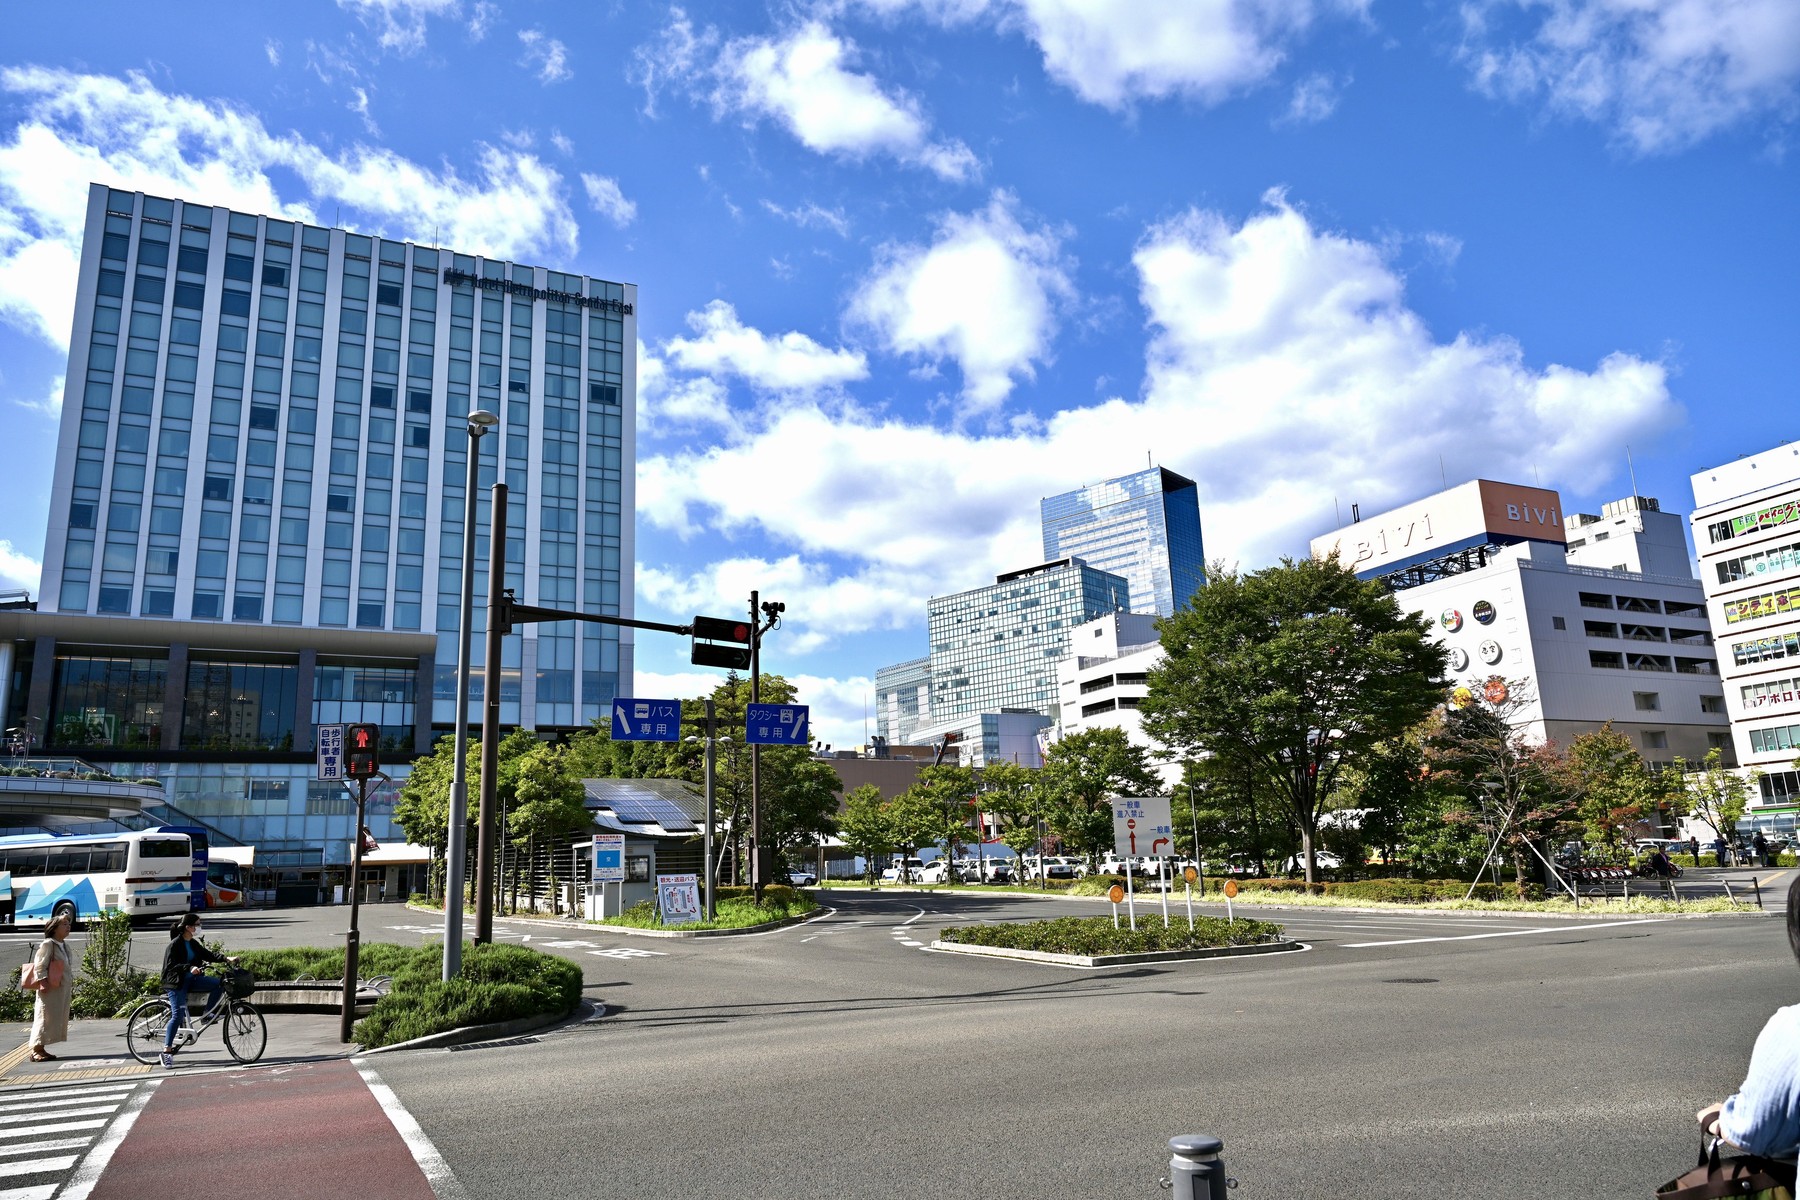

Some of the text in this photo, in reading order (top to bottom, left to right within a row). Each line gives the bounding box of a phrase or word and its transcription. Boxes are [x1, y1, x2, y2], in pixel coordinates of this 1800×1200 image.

[471, 273, 633, 315] Hotel Metropolitan Sendai East
[1505, 502, 1558, 527] BiVi
[1756, 691, 1800, 706] アポロ
[651, 706, 674, 718] バス
[750, 709, 779, 721] タクシー
[640, 723, 667, 735] 専用
[758, 726, 783, 738] 専用
[320, 728, 331, 756] 自転車
[331, 728, 341, 756] 歩行者
[323, 756, 337, 777] 専用
[1119, 800, 1141, 809] 一般車
[1117, 810, 1145, 818] 進入禁止
[1150, 825, 1170, 834] 一般車
